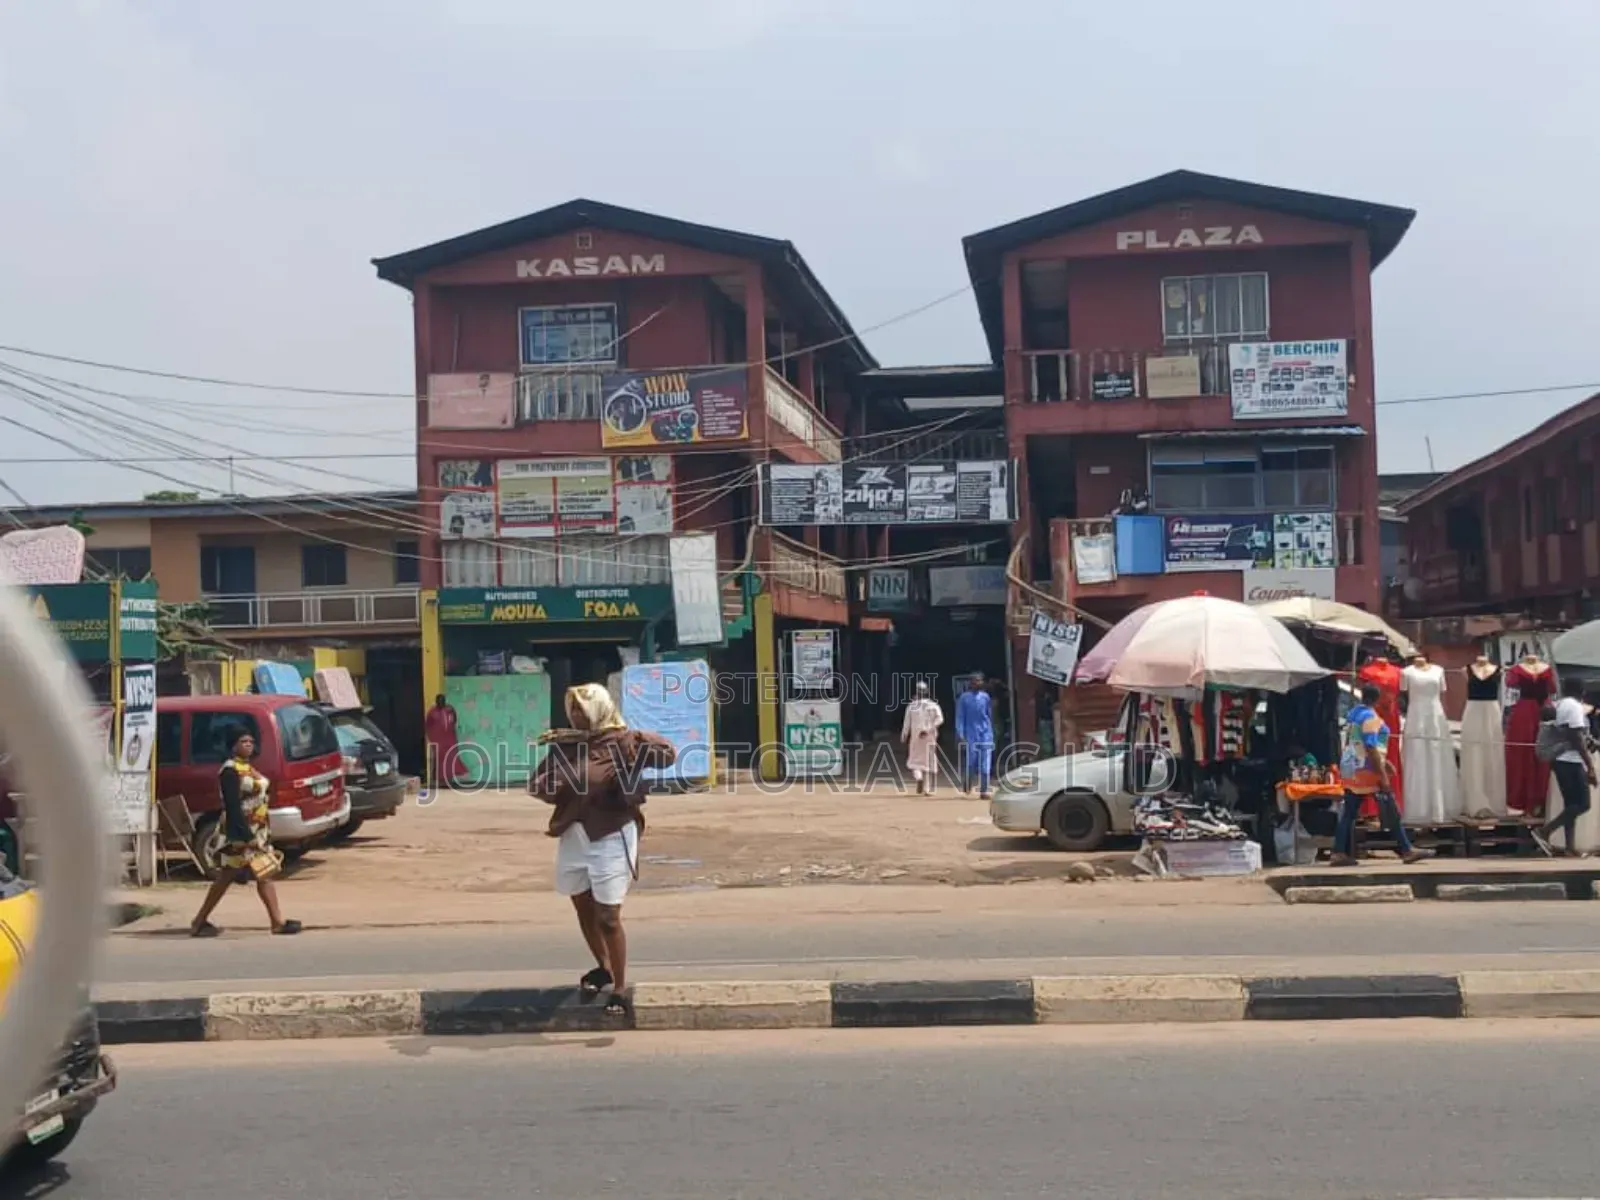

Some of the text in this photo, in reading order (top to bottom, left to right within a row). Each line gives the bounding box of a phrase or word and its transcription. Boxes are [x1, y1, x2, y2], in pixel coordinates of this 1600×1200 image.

[1116, 225, 1264, 250] PLAZA
[516, 254, 666, 278] KASAM
[1273, 342, 1339, 356] BERCHIN
[643, 373, 689, 393] WOW
[645, 391, 690, 409] STUDIO
[872, 575, 906, 595] NIN
[491, 603, 547, 621] MOUKA
[584, 600, 641, 618] FOAM
[1035, 614, 1077, 640] NYSC
[126, 675, 153, 708] NYSC
[790, 726, 838, 745] NYSC
